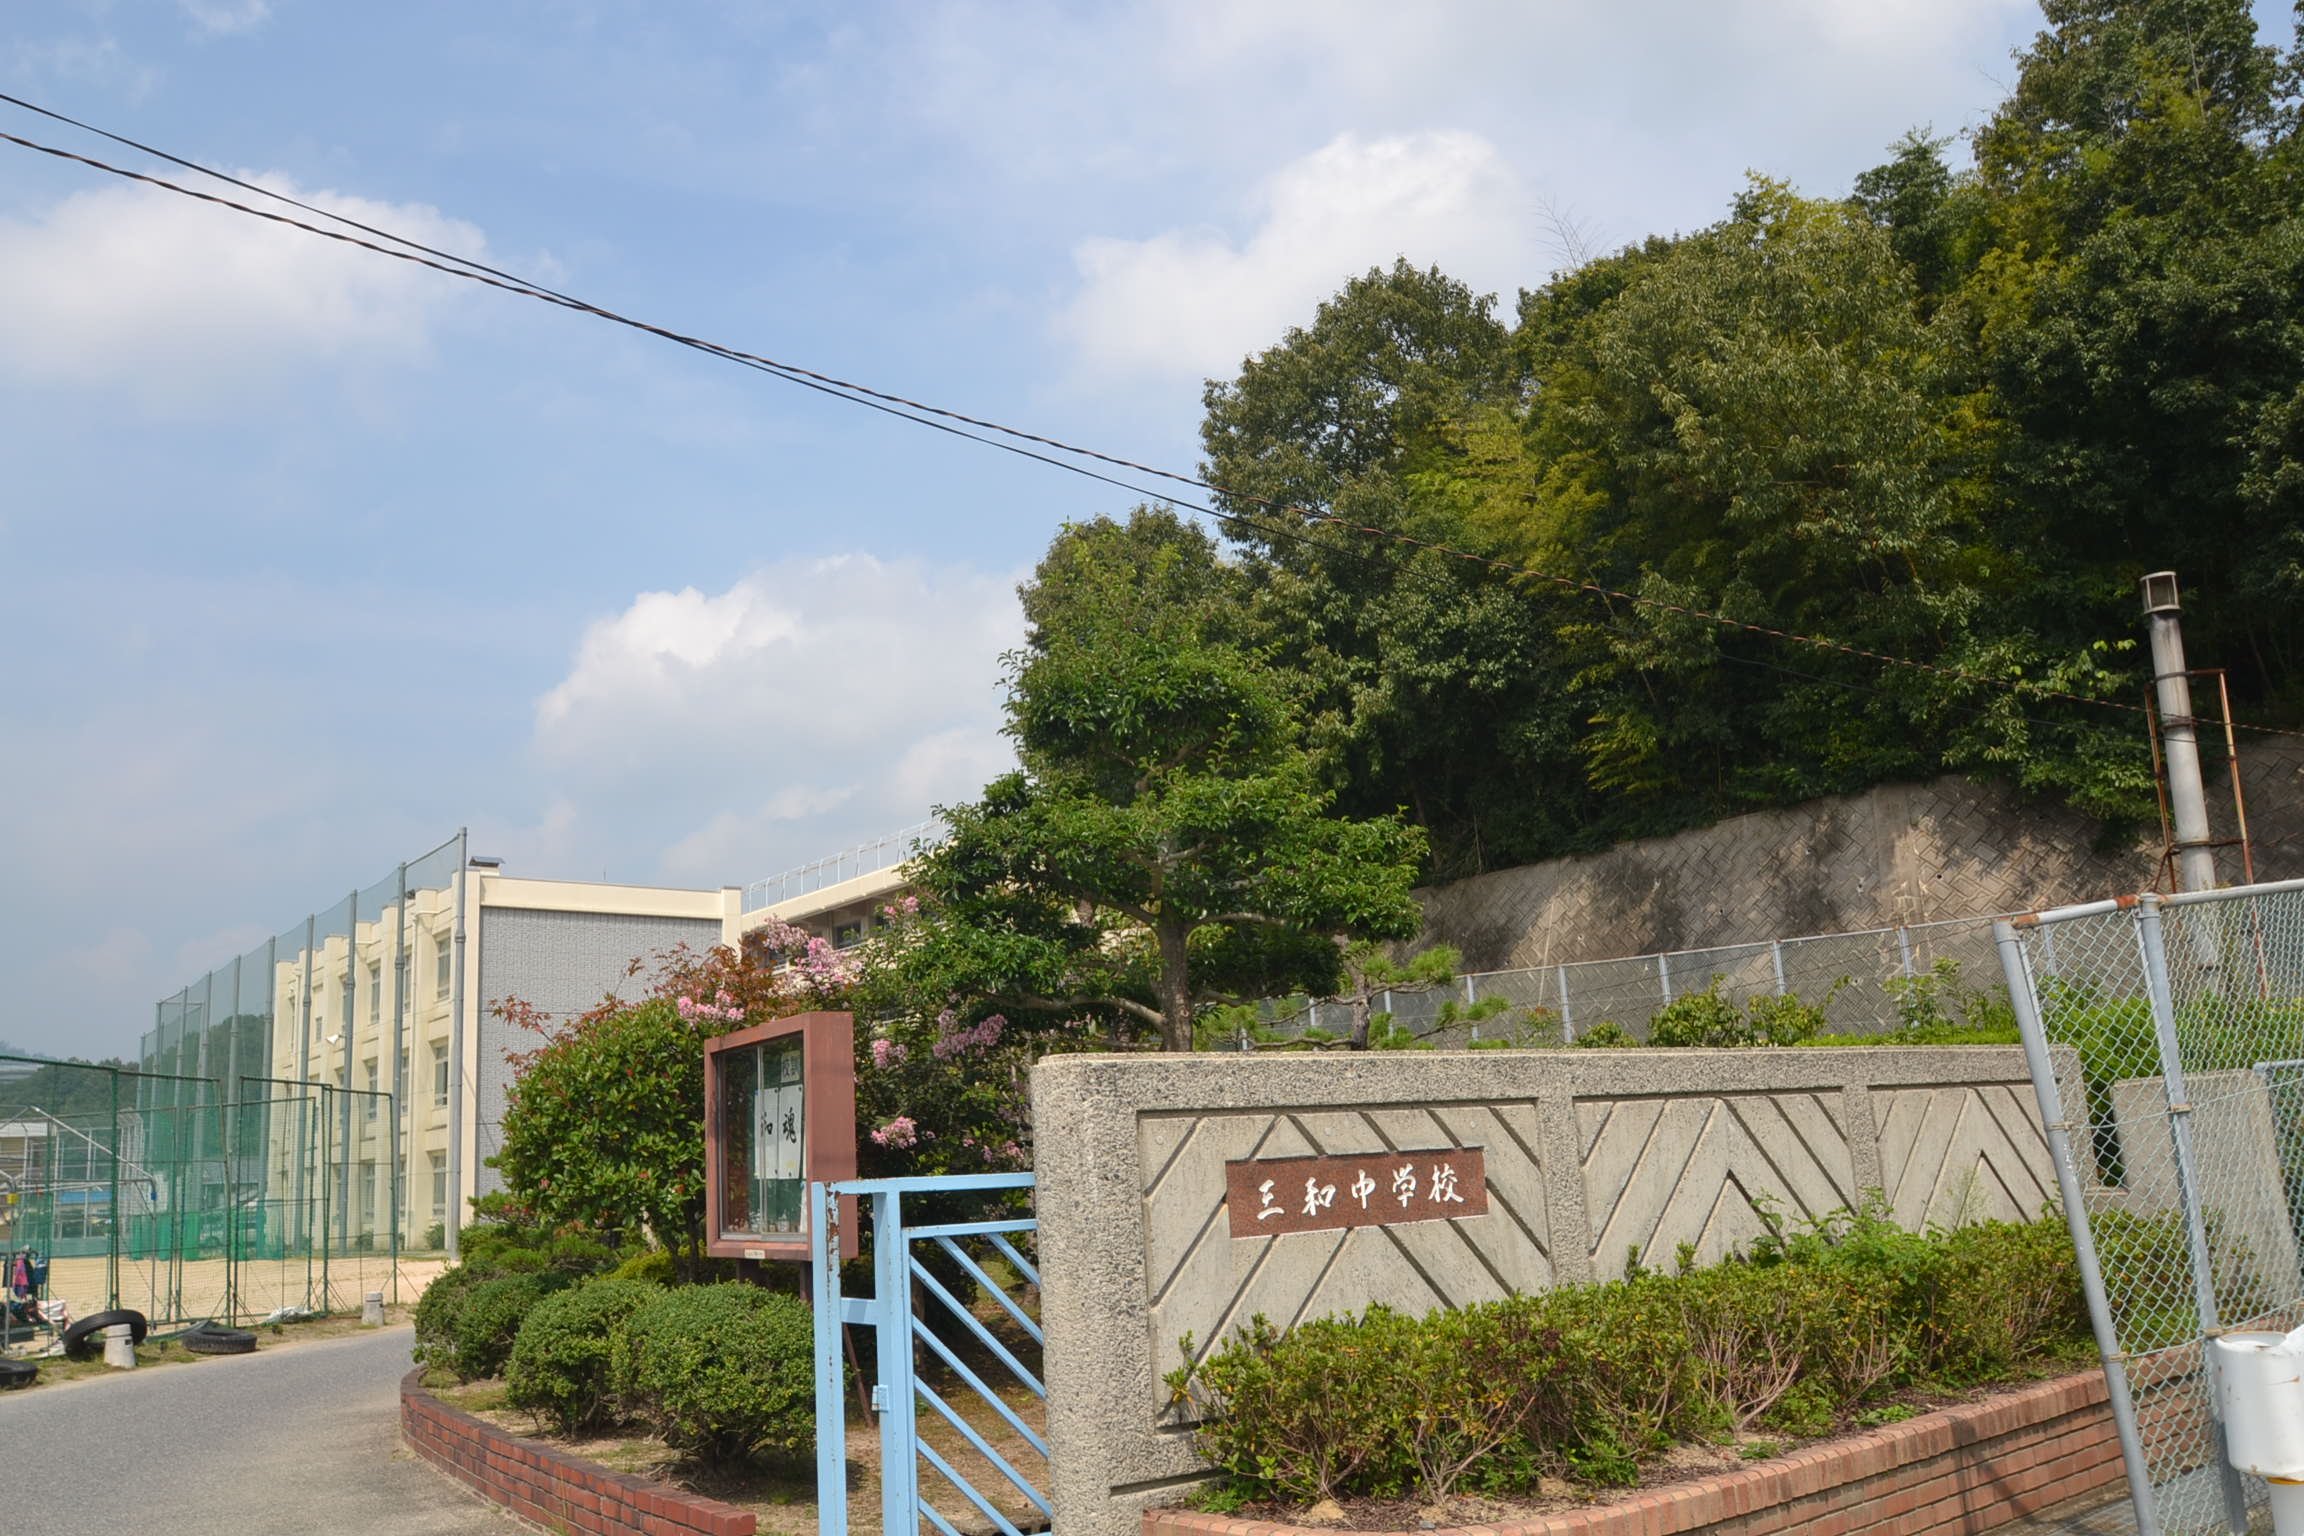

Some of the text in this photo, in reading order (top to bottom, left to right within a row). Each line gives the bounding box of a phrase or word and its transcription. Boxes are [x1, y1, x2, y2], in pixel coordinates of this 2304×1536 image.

[1257, 1163, 1464, 1220] 三和中学校
